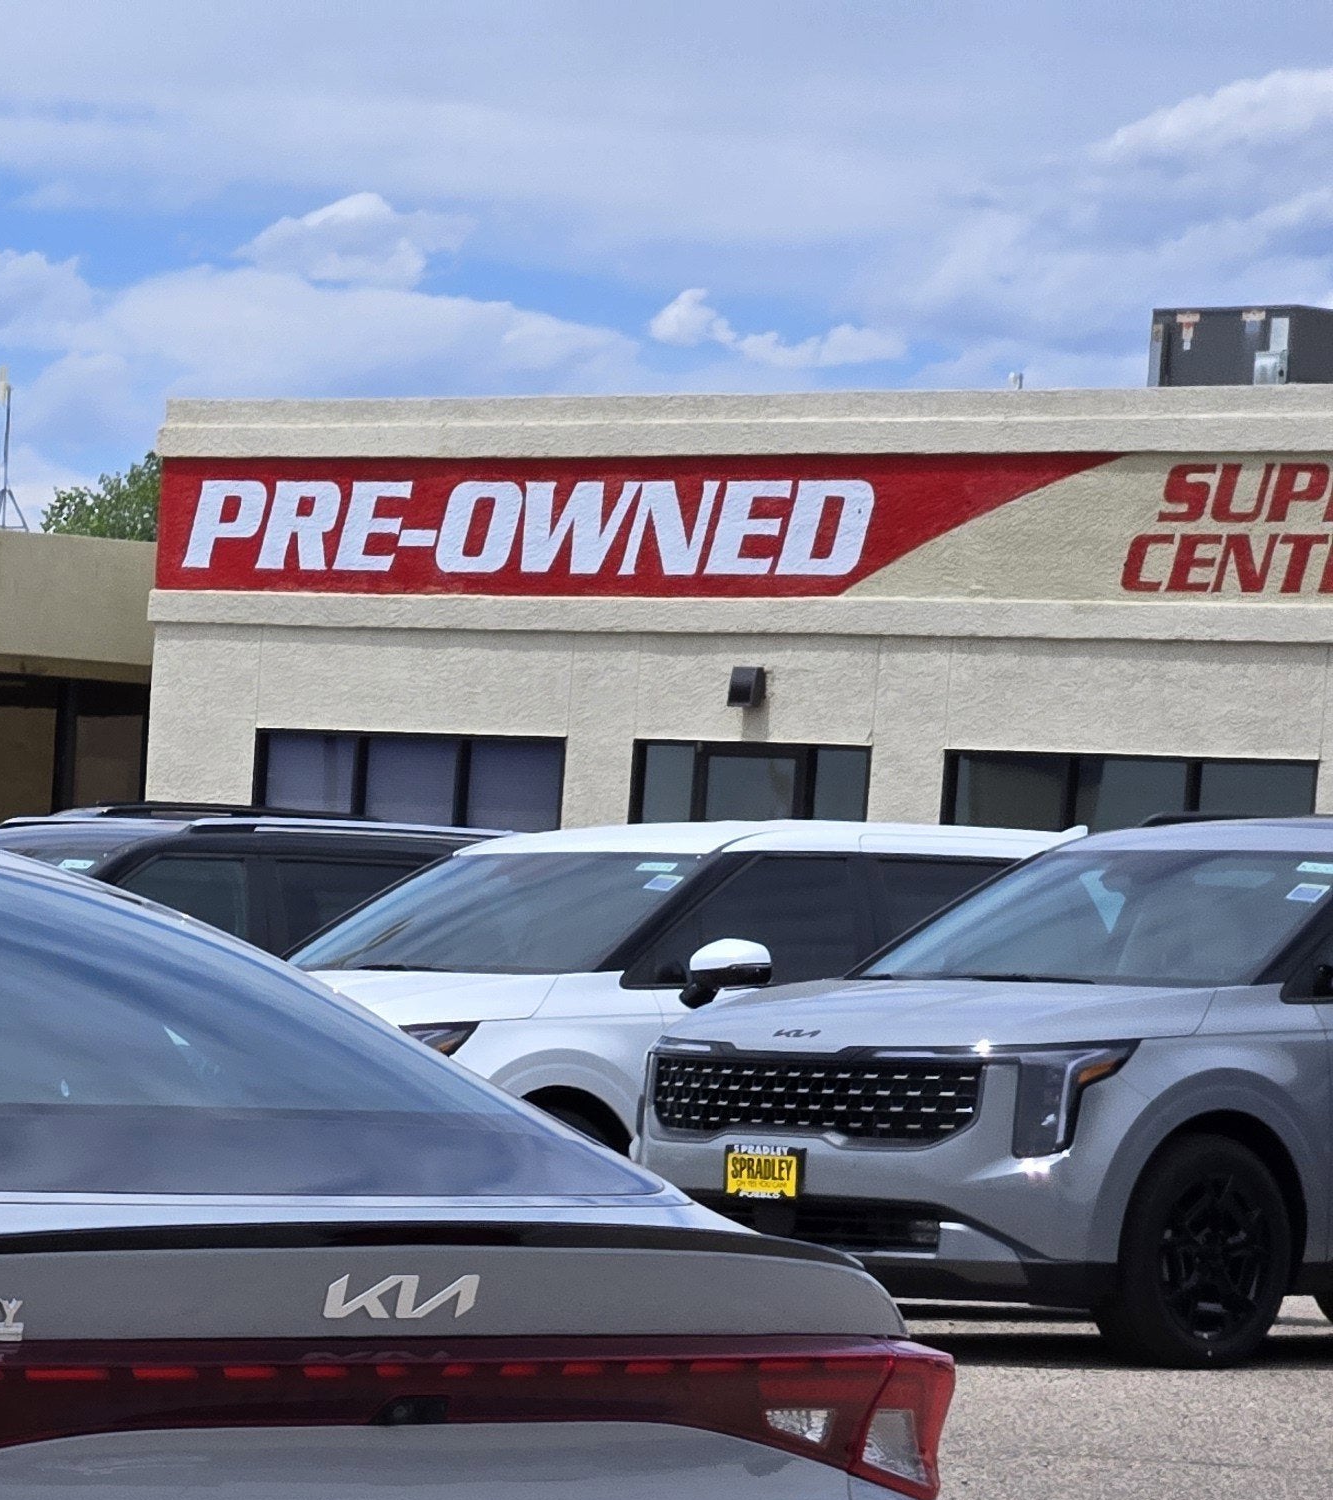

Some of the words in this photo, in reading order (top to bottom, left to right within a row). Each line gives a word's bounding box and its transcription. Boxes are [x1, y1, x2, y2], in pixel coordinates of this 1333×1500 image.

[1156, 462, 1333, 523] SUP
[180, 478, 875, 576] PRE-OWNED
[1120, 533, 1333, 593] CENT
[731, 1156, 793, 1181] SPRADLEY
[733, 1144, 790, 1156] SPRADLEY
[323, 1273, 481, 1319] KIA
